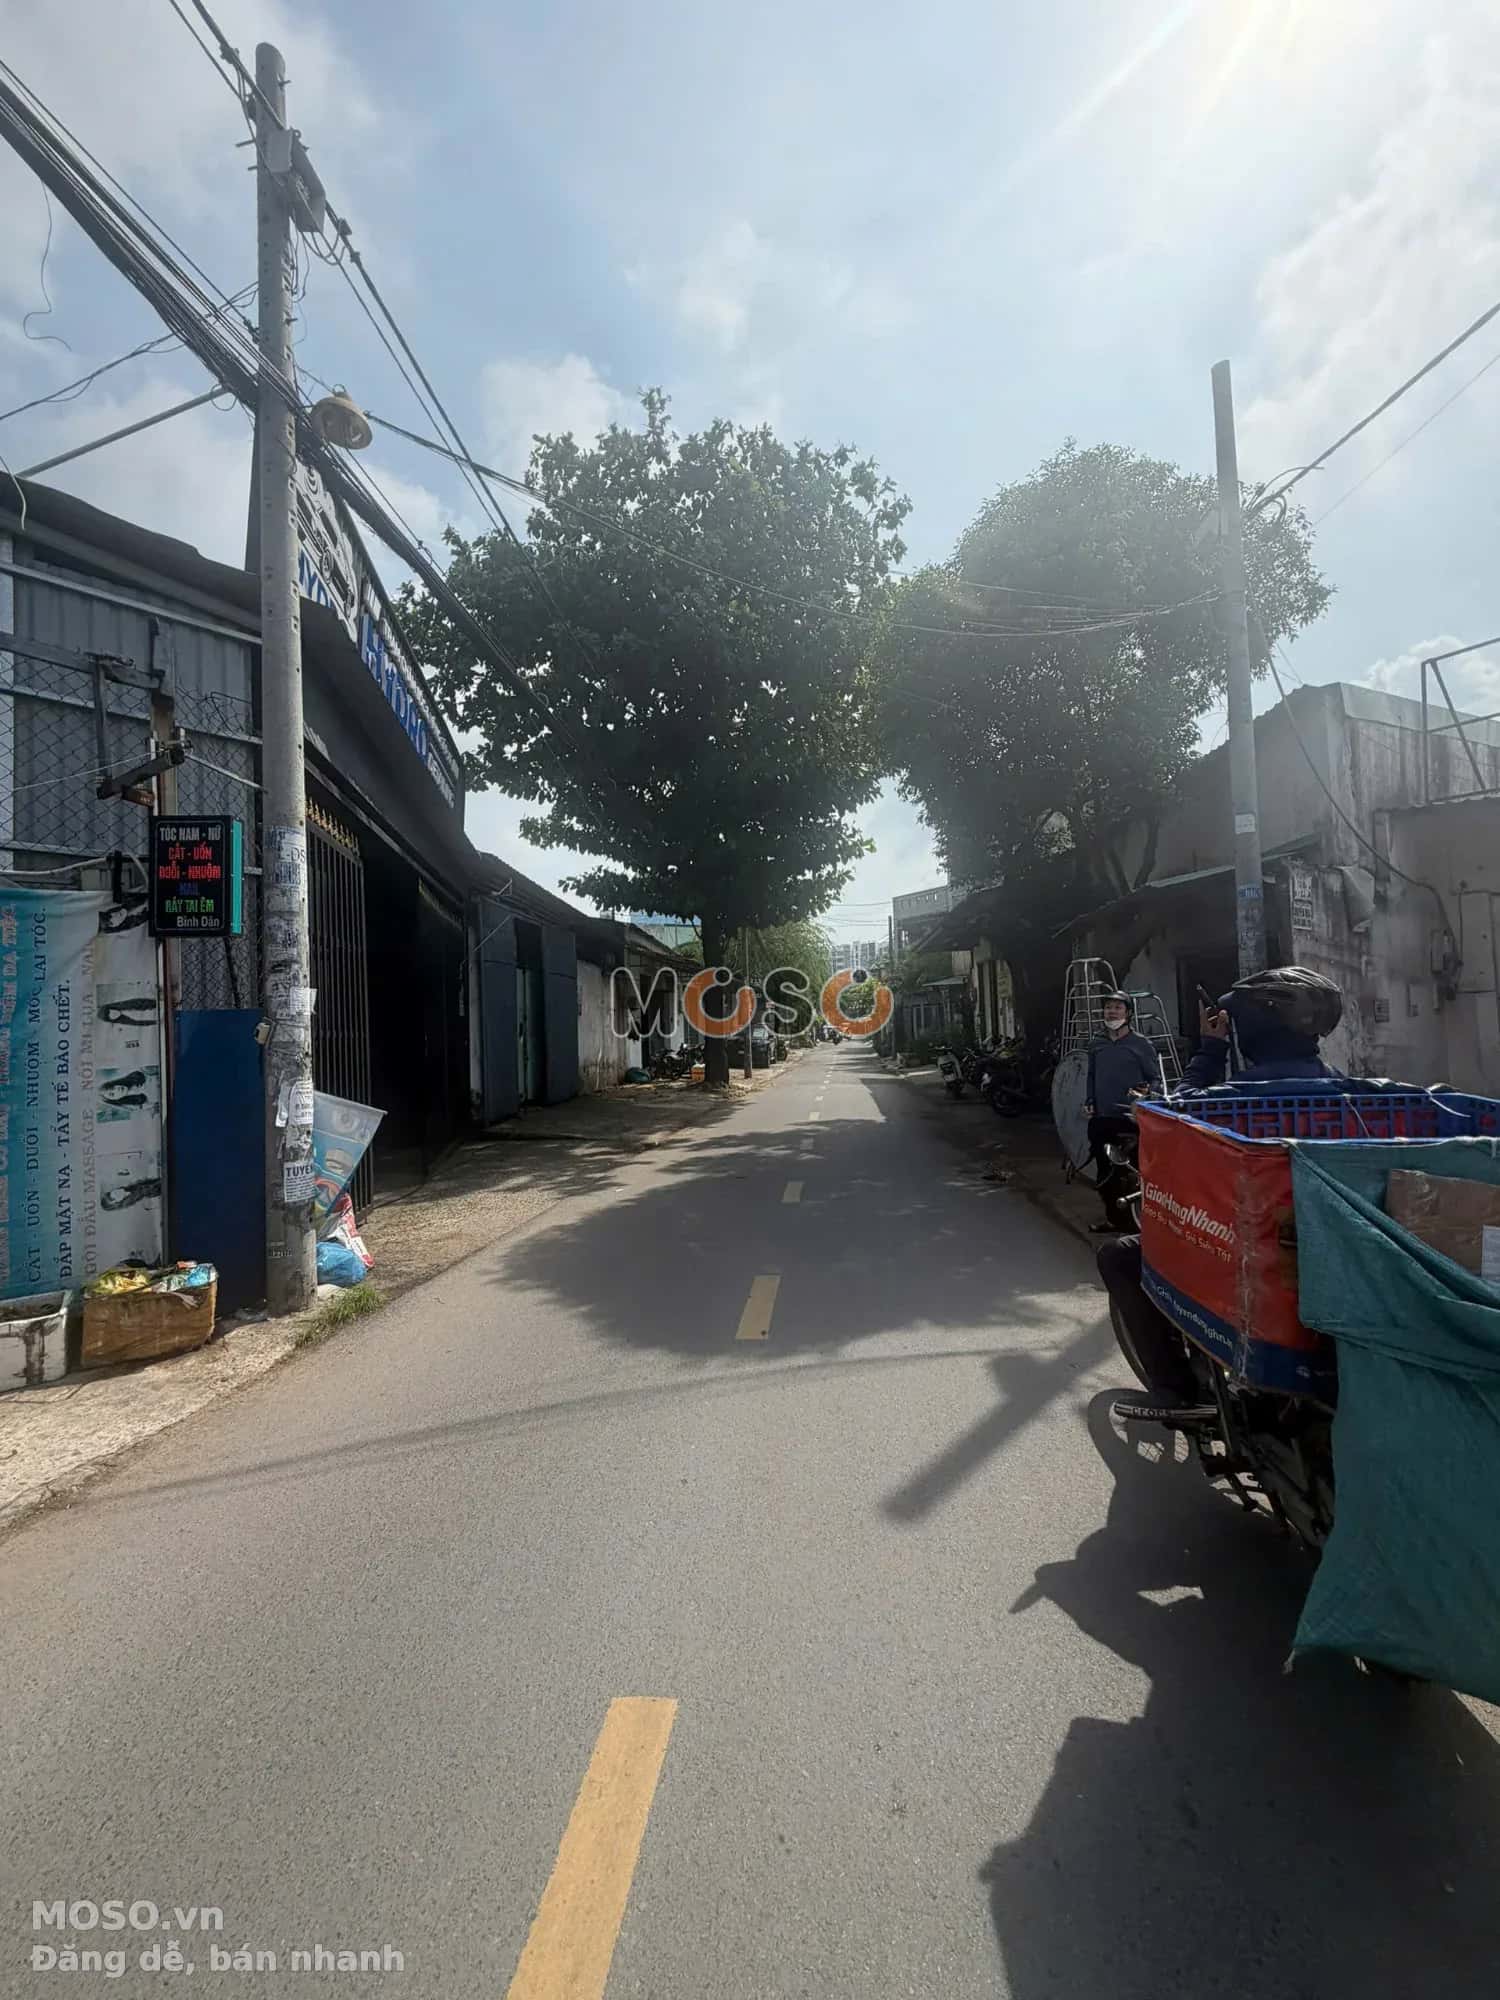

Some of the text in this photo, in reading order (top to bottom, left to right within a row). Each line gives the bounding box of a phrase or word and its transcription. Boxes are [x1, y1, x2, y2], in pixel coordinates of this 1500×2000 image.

[160, 824, 222, 841] TÓC NAM NỮ
[193, 841, 213, 860] UỐN
[184, 899, 198, 913] TAI
[200, 896, 215, 913] ÊM
[177, 915, 199, 928] Bình
[51, 979, 71, 1033] CHẾT.
[53, 1038, 71, 1075] BÀO
[50, 1081, 71, 1106] TẾ
[49, 1112, 70, 1147] TẨY
[81, 1110, 97, 1193] MASSAGE
[58, 1164, 73, 1190] NẠ
[56, 1197, 74, 1236] MẶT
